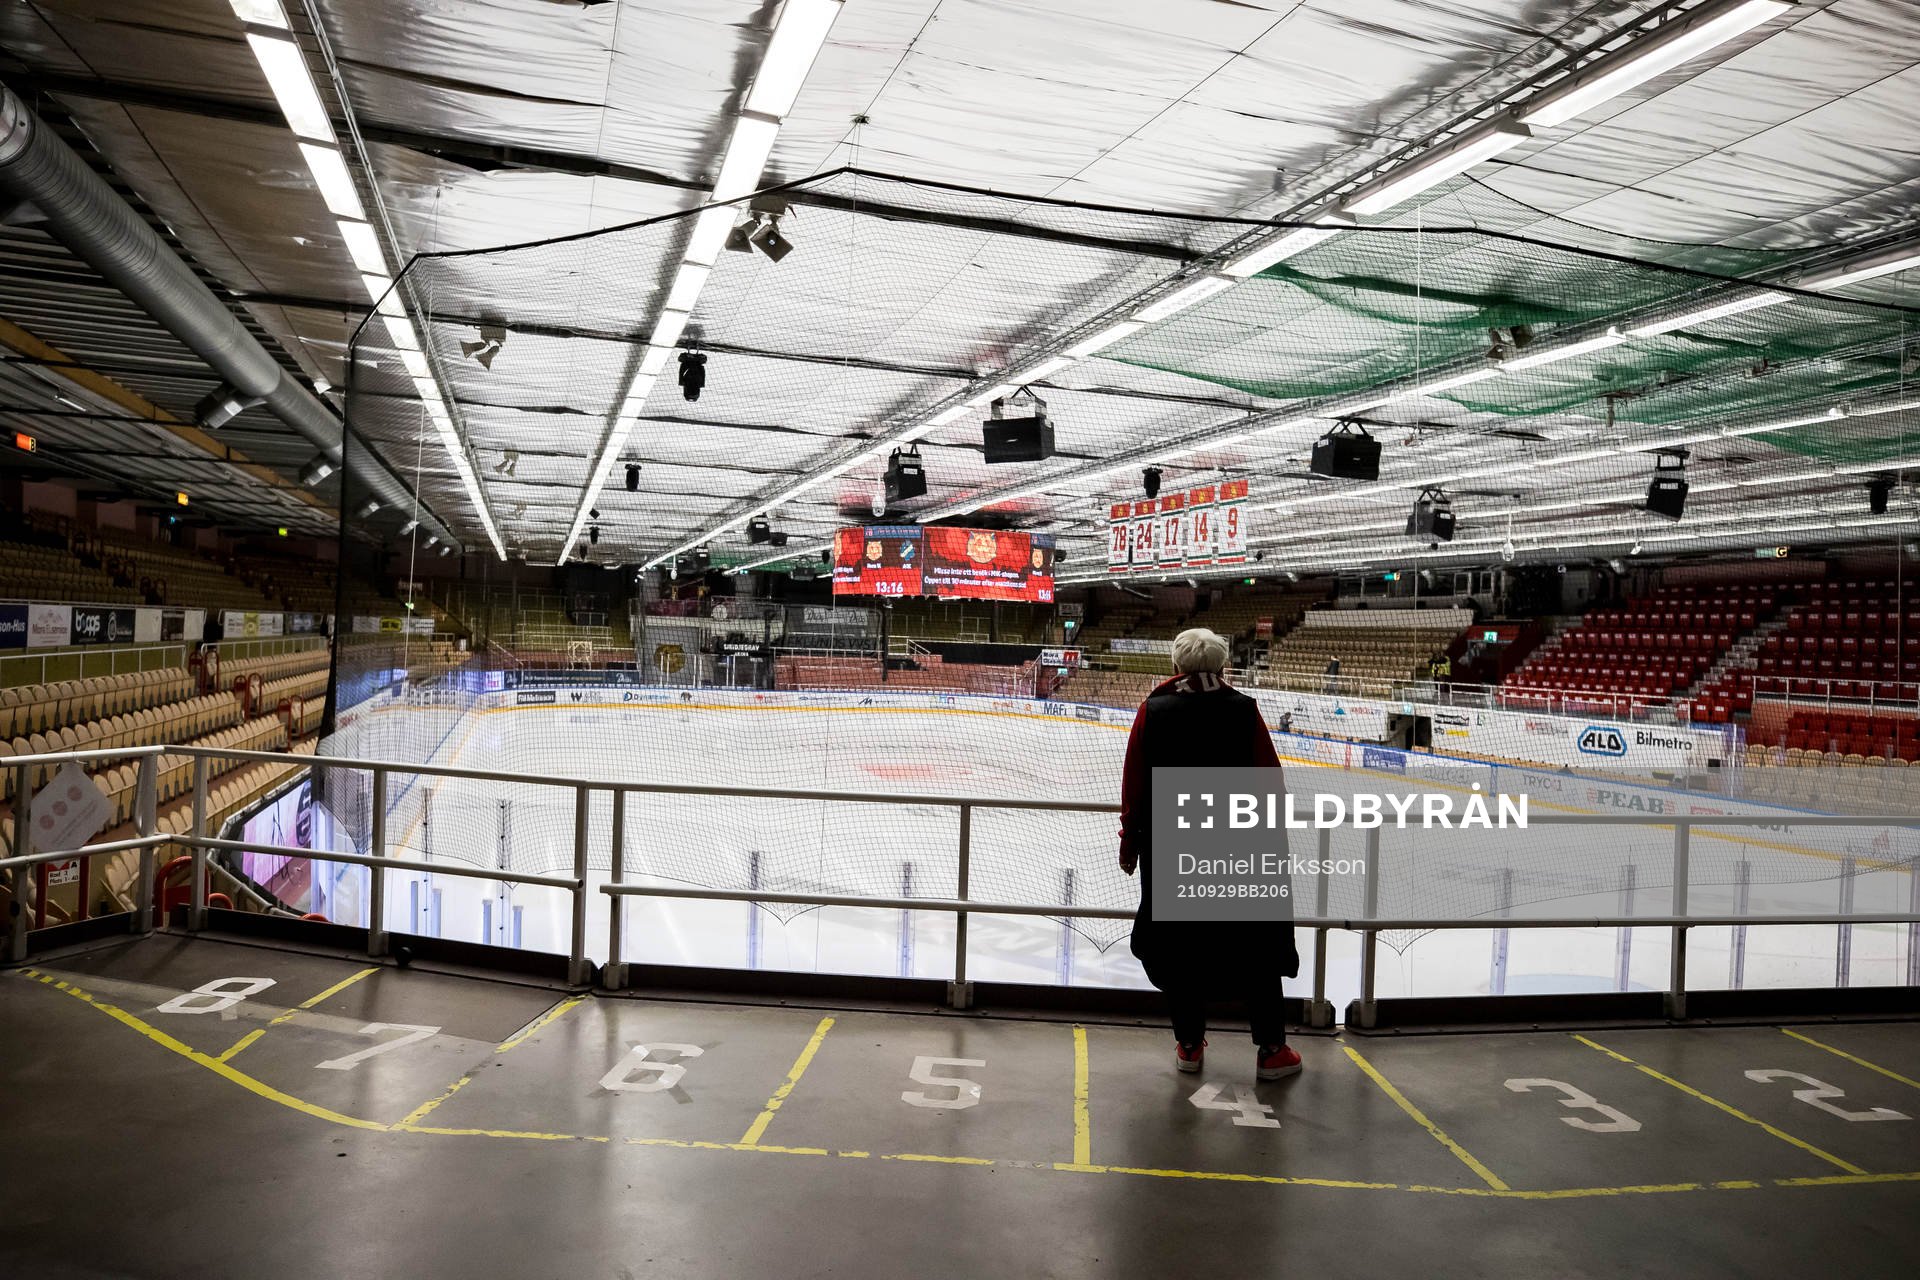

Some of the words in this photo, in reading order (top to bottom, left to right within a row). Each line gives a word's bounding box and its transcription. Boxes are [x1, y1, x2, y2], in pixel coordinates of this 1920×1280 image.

[1113, 525, 1126, 551] 78
[1137, 522, 1152, 549] 24
[1164, 518, 1179, 546] 17
[1194, 512, 1208, 542] 14
[1228, 507, 1238, 538] 9
[875, 582, 904, 593] 13:16
[1636, 731, 1693, 751] Bilmetro
[1597, 789, 1665, 814] PEAB
[157, 977, 278, 1014] 8
[315, 1023, 442, 1071] 7
[599, 1043, 705, 1092] 6
[902, 1056, 986, 1110] 5
[1189, 1082, 1282, 1129] 4
[1503, 1077, 1642, 1133] 3
[1743, 1067, 1914, 1122] 2
